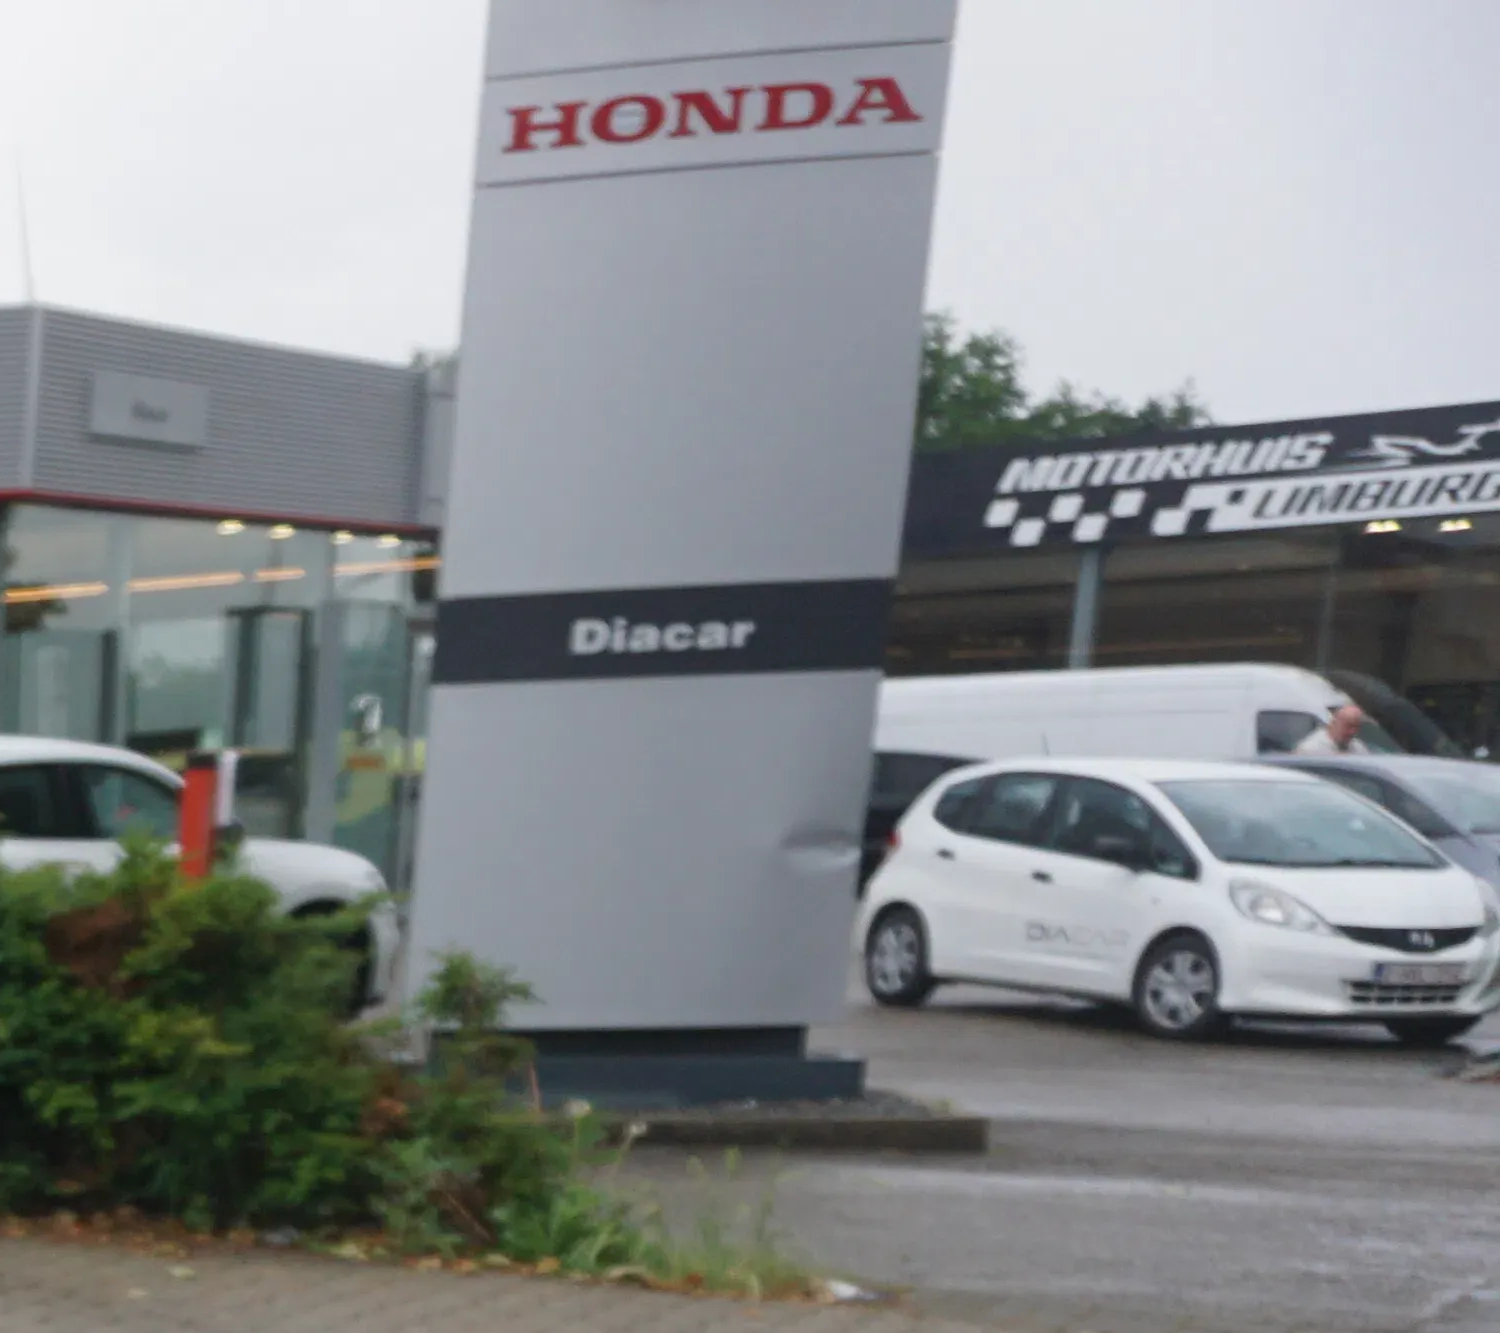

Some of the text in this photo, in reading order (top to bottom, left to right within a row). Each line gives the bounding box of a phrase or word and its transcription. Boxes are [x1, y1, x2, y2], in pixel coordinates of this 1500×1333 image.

[501, 76, 924, 154] HONDA
[996, 431, 1334, 494] MOTORHUIS
[569, 615, 757, 657] Diacar
